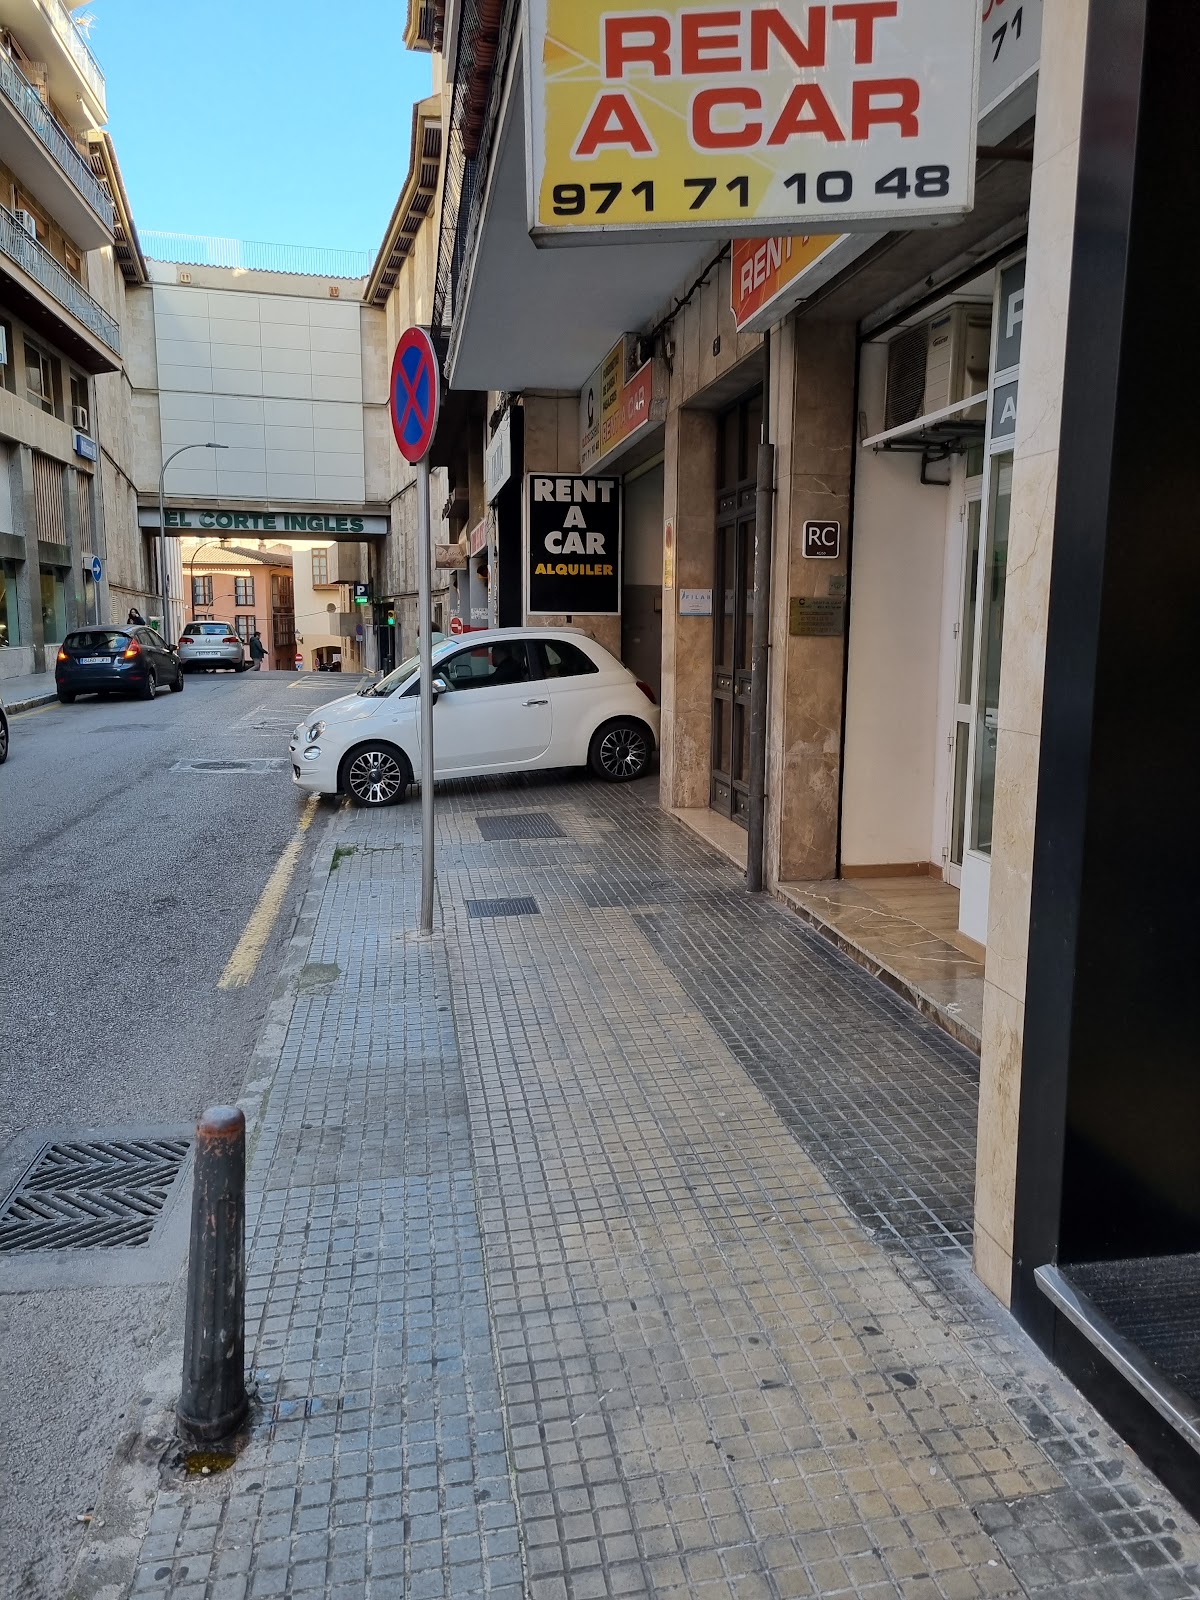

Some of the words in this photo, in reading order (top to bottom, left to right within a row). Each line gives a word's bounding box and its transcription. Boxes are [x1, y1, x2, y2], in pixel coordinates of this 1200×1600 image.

[604, 2, 898, 79] RENT
[575, 94, 654, 156] A
[692, 78, 920, 149] CAR
[552, 180, 655, 217] 971
[684, 176, 749, 210] 71
[783, 170, 853, 204] 10
[875, 165, 950, 200] 48
[602, 408, 620, 446] RENT
[627, 386, 645, 420] CAR
[534, 478, 615, 503] RENT
[164, 511, 192, 528] EL
[198, 512, 276, 530] CORTE
[284, 515, 364, 532] INGLES
[563, 505, 587, 528] A
[544, 530, 606, 555] CAR
[808, 526, 836, 546] RC
[535, 563, 613, 576] ALQUILER
[356, 585, 365, 595] P
